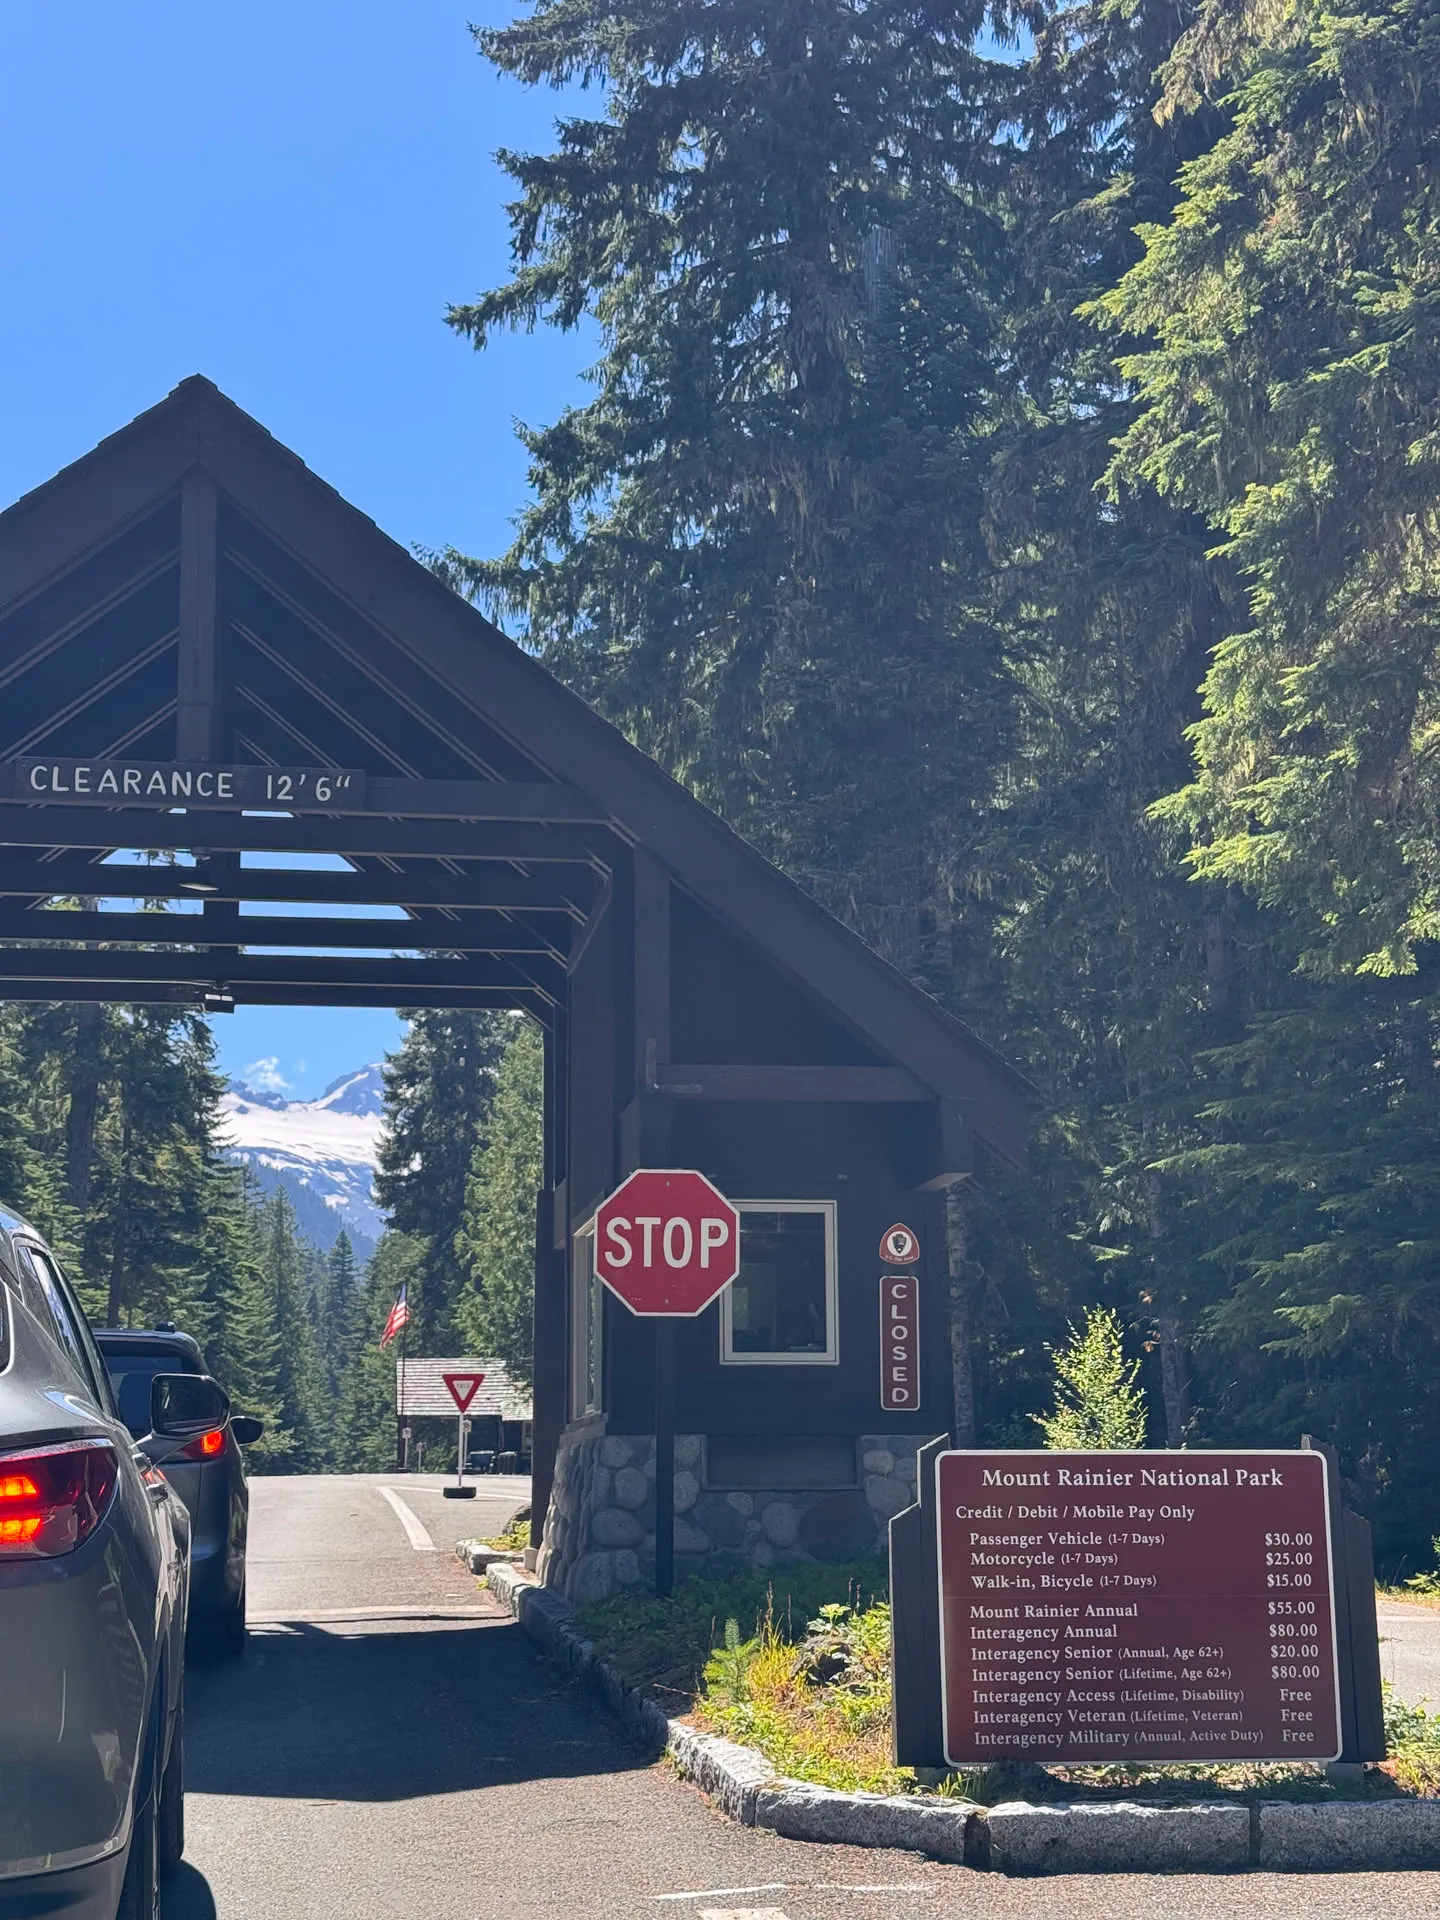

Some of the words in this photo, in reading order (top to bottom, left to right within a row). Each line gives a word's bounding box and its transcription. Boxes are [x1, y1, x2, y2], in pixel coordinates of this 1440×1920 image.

[31, 766, 233, 797] CLEARANCE
[605, 1217, 728, 1268] STOP
[891, 1283, 909, 1402] CLOSED
[981, 1469, 1051, 1486] Mount
[1056, 1468, 1134, 1485] Rainier
[1139, 1468, 1230, 1485] National
[1235, 1468, 1284, 1485] Park
[955, 1505, 1003, 1519] Credit
[1007, 1506, 1013, 1519] /
[1017, 1505, 1059, 1519] Debit
[1062, 1506, 1069, 1518] /
[1072, 1504, 1124, 1518] Mobile
[1128, 1505, 1155, 1521] Pay
[1159, 1504, 1195, 1521] Only
[969, 1532, 1043, 1548] Passenger
[1047, 1531, 1103, 1545] Vehicle
[1108, 1533, 1129, 1546] (1-7
[1131, 1533, 1165, 1547] Days)
[1265, 1532, 1313, 1547] $30.00
[970, 1551, 1055, 1568] Motorcycle
[1061, 1552, 1082, 1566] (1-7
[1084, 1552, 1118, 1567] Days)
[1265, 1552, 1313, 1566] $25.00
[970, 1574, 1036, 1590] Walk-in,
[1040, 1573, 1094, 1590] Bicycle
[1099, 1575, 1120, 1588] (1-7
[1123, 1575, 1157, 1589] Days)
[1266, 1573, 1312, 1588] $15.00
[970, 1605, 1020, 1619] Mount
[1023, 1604, 1080, 1618] Rainier
[1084, 1602, 1138, 1617] Annual
[1268, 1601, 1315, 1616] $55.00
[970, 1626, 1059, 1642] Interagency
[1063, 1623, 1118, 1638] Annual
[1269, 1623, 1318, 1638] $80.00
[971, 1647, 1060, 1663] Interagency
[1064, 1645, 1113, 1659] Senior
[1118, 1646, 1169, 1660] (Annual,
[1173, 1647, 1195, 1661] Age
[1198, 1646, 1224, 1659] 62+)
[1270, 1644, 1319, 1659] $20.00
[972, 1668, 1061, 1684] Interagency
[1065, 1666, 1114, 1680] Senior
[1119, 1667, 1178, 1681] (Lifetime,
[1180, 1667, 1203, 1682] Age
[1206, 1667, 1232, 1680] 62+)
[1271, 1665, 1320, 1680] $80.00
[972, 1689, 1062, 1706] Interagency
[1066, 1688, 1116, 1702] Access
[1120, 1689, 1179, 1703] (Lifetime,
[1182, 1688, 1244, 1703] Disability)
[1279, 1688, 1312, 1702] Free
[973, 1710, 1063, 1726] Interagency
[1067, 1709, 1126, 1722] Veteran
[1130, 1709, 1189, 1724] (Lifetime,
[1191, 1710, 1243, 1722] Veteran)
[1280, 1708, 1313, 1722] Free
[974, 1731, 1064, 1748] Interagency
[1069, 1729, 1130, 1745] Military
[1134, 1729, 1186, 1744] (Annual,
[1189, 1729, 1227, 1742] Active
[1230, 1729, 1264, 1744] Duty)
[1282, 1729, 1314, 1742] Free
